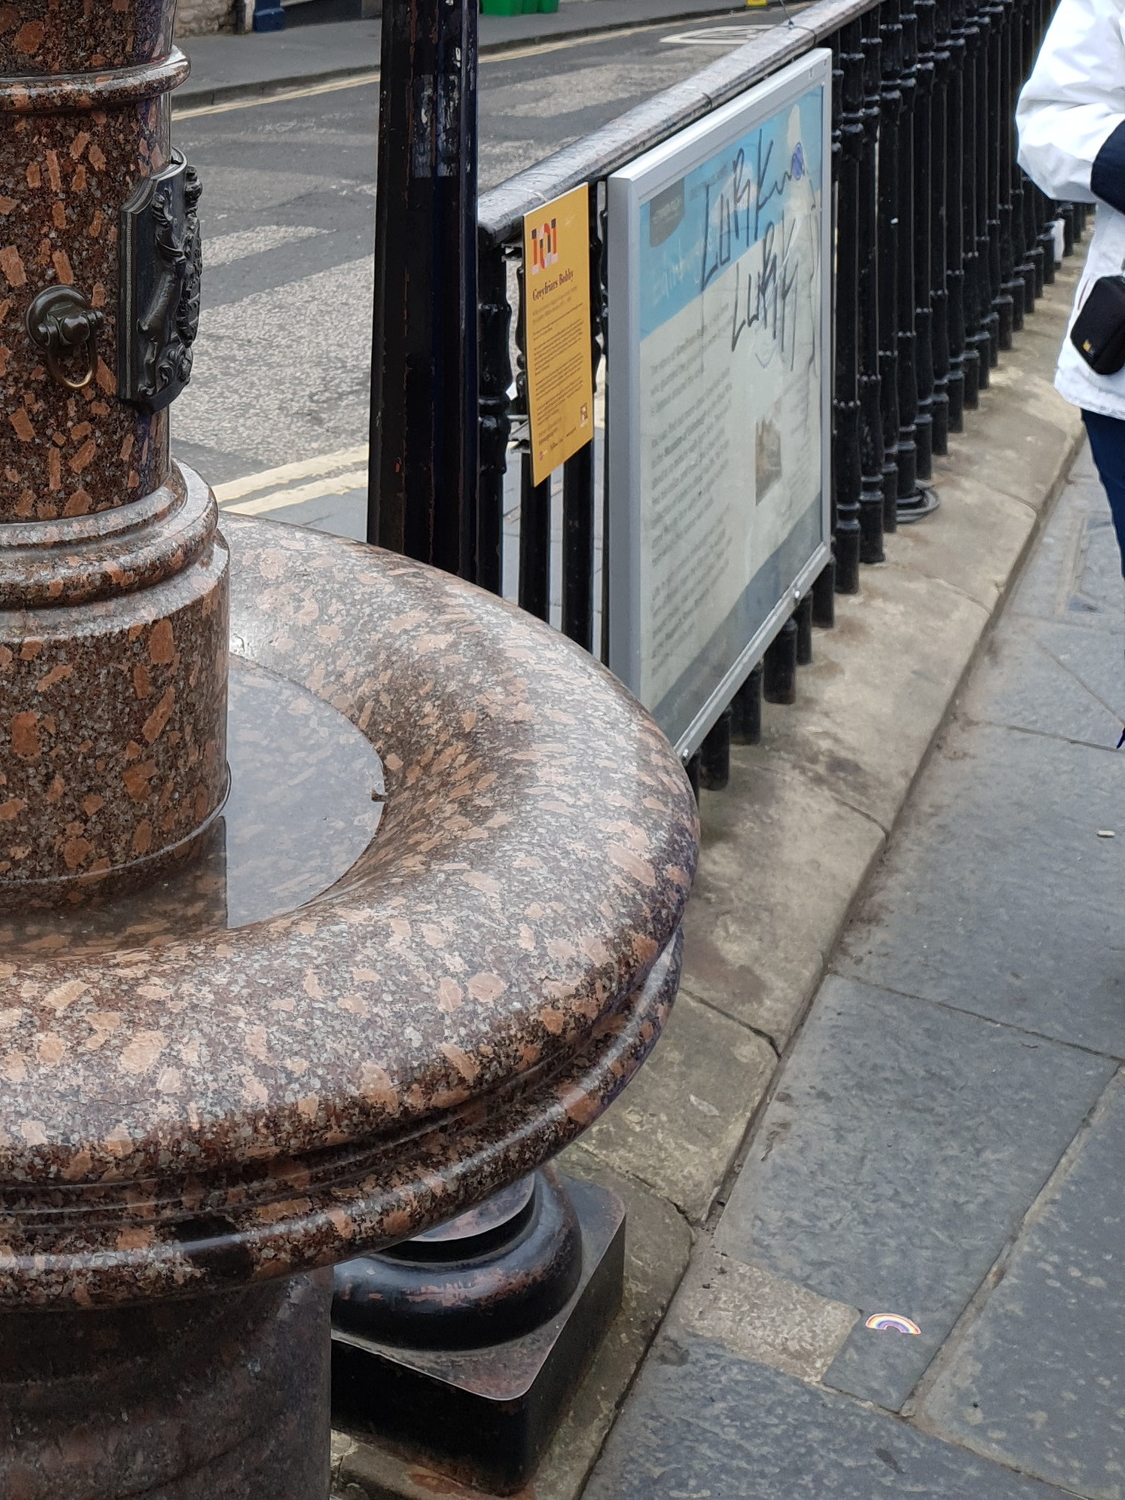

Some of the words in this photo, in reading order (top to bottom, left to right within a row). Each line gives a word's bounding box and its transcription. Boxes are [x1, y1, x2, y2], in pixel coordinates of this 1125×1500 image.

[531, 218, 558, 276] 101
[532, 278, 558, 302] Greyfriars
[558, 268, 574, 286] Bobby
